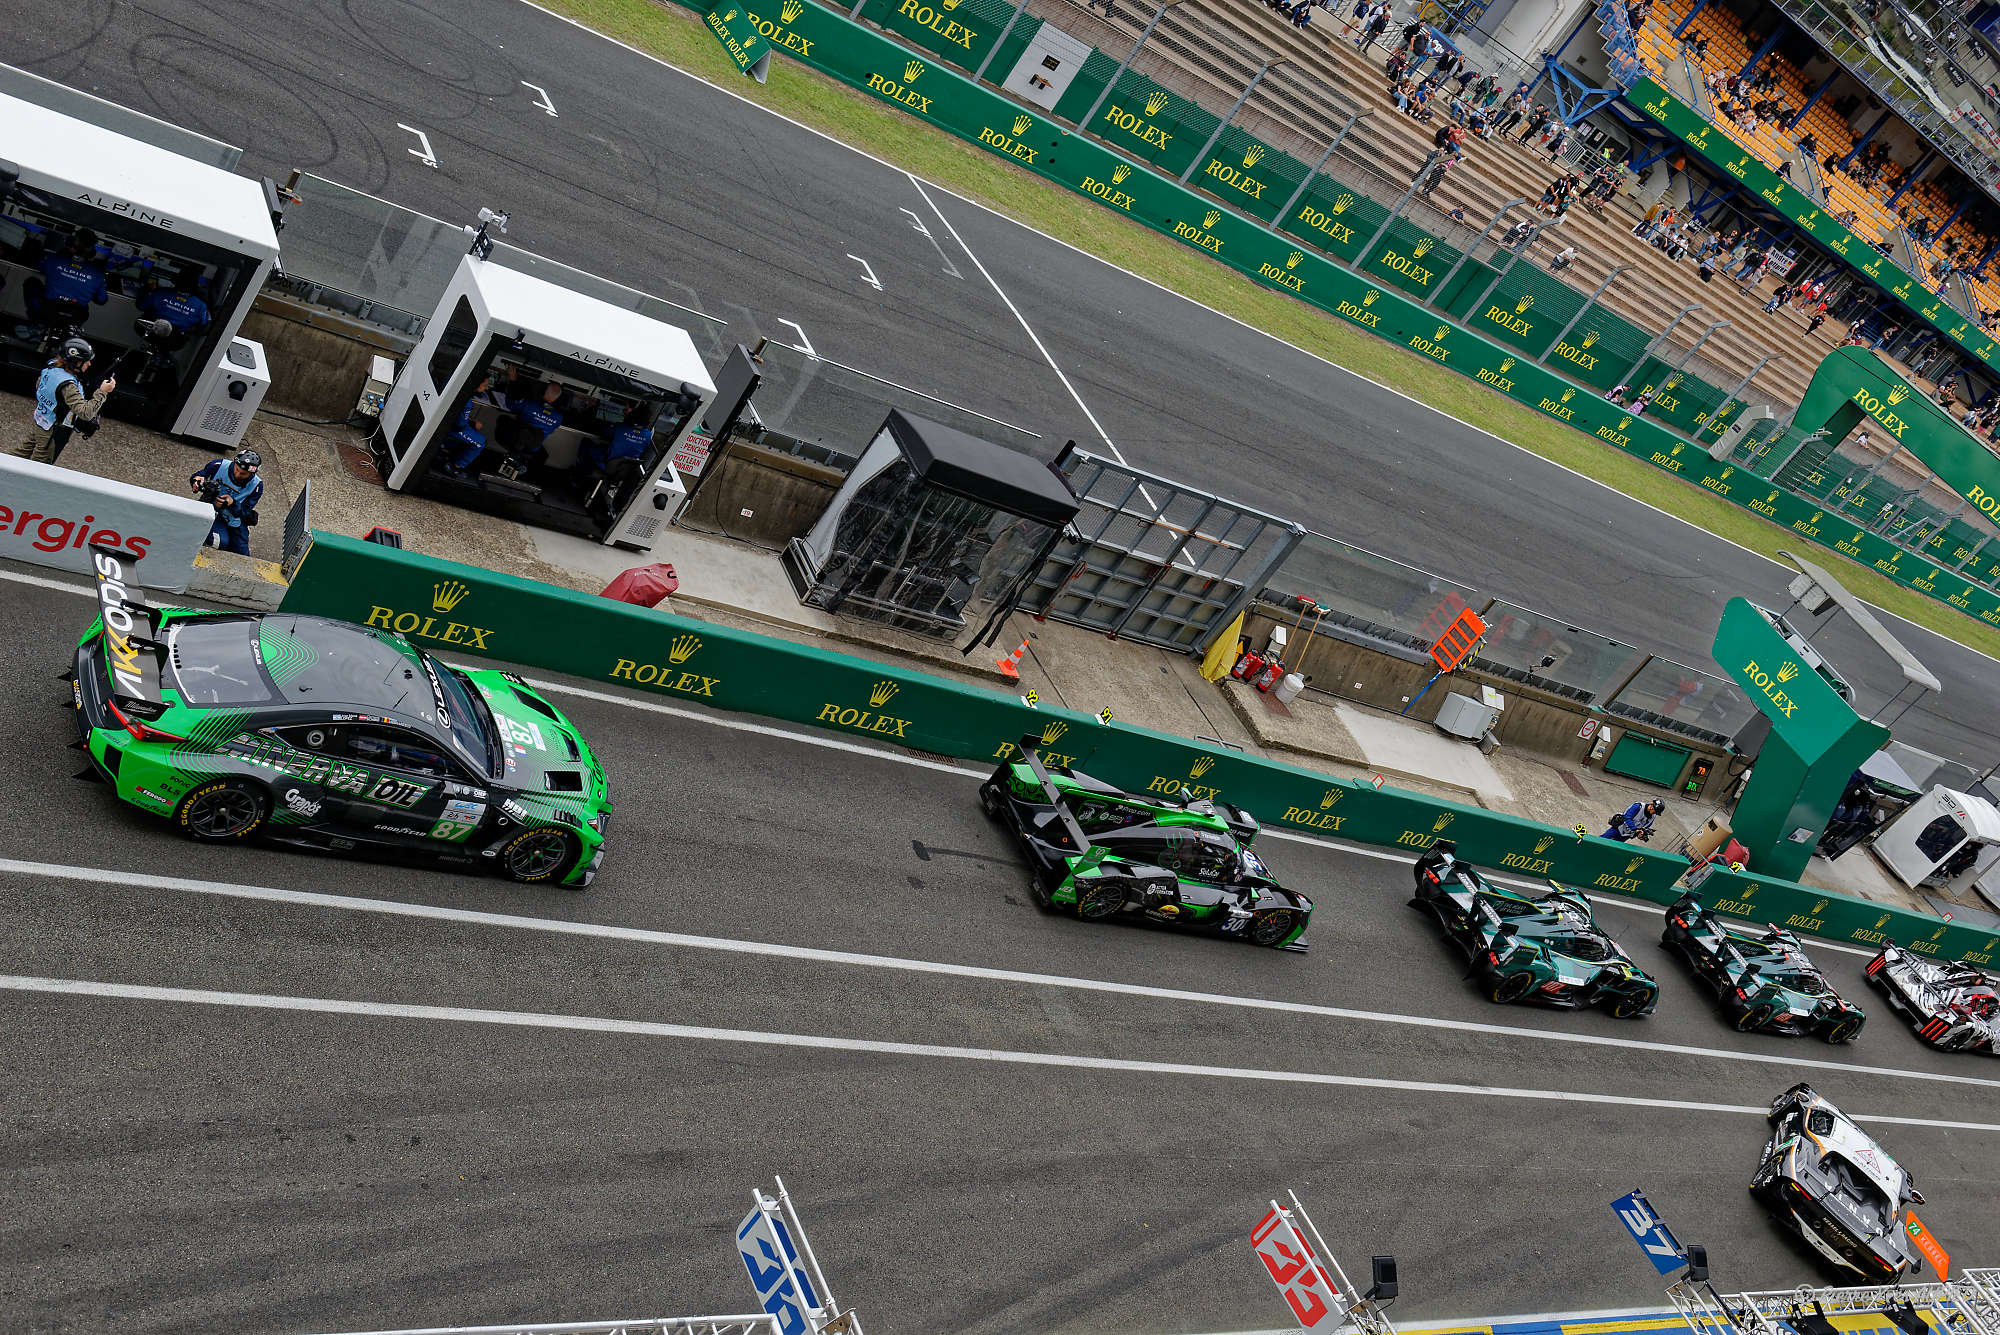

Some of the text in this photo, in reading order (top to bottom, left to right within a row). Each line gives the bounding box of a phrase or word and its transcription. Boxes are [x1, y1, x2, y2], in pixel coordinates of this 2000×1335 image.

[708, 12, 729, 40] ROLEX
[748, 12, 815, 57] ROLEX
[898, 0, 978, 49] ROLEX
[727, 37, 750, 68] ROLEX
[866, 73, 933, 114] ROLEX
[1645, 102, 1667, 121] ROLEX
[1104, 105, 1173, 150] ROLEX
[978, 127, 1039, 164] ROLEX
[1686, 132, 1708, 150] ROLEX
[1205, 158, 1268, 199] ROLEX
[1726, 161, 1747, 179] ROLEX
[1080, 176, 1136, 211] ROLEX
[1762, 189, 1782, 205] ROLEX
[78, 193, 175, 229] ALPINE
[1298, 205, 1355, 244] ROLEX
[1797, 215, 1816, 230] ROLEX
[1173, 222, 1225, 253] ROLEX
[1830, 241, 1848, 255] ROLEX
[56, 265, 93, 281] ALPINE
[1258, 263, 1306, 292] ROLEX
[1381, 250, 1434, 286] ROLEX
[1862, 263, 1880, 278] ROLEX
[1893, 285, 1909, 300] ROLEX
[162, 297, 196, 314] ALPINE
[1336, 300, 1381, 328] ROLEX
[1921, 307, 1938, 320] ROLEX
[1485, 305, 1534, 337] ROLEX
[1949, 328, 1965, 341] ROLEX
[1409, 336, 1450, 361] ROLEX
[1554, 341, 1599, 371] ROLEX
[570, 351, 640, 378] ALPINE
[1476, 368, 1516, 392] ROLEX
[532, 411, 558, 425] ALPINE
[1538, 398, 1575, 421] ROLEX
[1852, 387, 1910, 438] ROLEX
[1596, 425, 1631, 447] ROLEX
[1650, 452, 1683, 472] ROLEX
[1701, 476, 1730, 496] ROLEX
[1835, 486, 1865, 507] ROEX
[1748, 499, 1776, 517] ROLEX
[1966, 485, 2000, 525] ROL
[1793, 520, 1820, 538] ROLEX
[1835, 539, 1861, 556] ROLEX
[1874, 559, 1899, 575] ROLEX
[1912, 577, 1936, 592] ROLEX
[1947, 594, 1971, 608] ROLEX
[363, 605, 496, 650] ROLEX
[423, 659, 445, 708] LEXUS
[609, 659, 721, 697] ROLEX
[1744, 660, 1798, 719] ROLEX
[816, 703, 912, 740] ROLEX
[512, 721, 534, 745] 87
[993, 742, 1077, 769] RLEX
[209, 731, 422, 808] MINERVA OIL
[1146, 776, 1222, 803] ROLEX
[1281, 807, 1348, 830] ROLEX
[374, 823, 427, 837] GOODYEAR
[432, 820, 469, 841] 87
[1575, 823, 1587, 837] 92
[1501, 853, 1553, 874] ROLEX
[1730, 862, 1741, 873] 91
[1593, 874, 1642, 892] ROLEX
[1713, 899, 1757, 915] ROLEX
[1222, 918, 1246, 932] 30
[1785, 914, 1824, 930] ROLEX
[1850, 929, 1886, 943] ROLEX
[1909, 941, 1941, 954] ROLEX
[1963, 952, 1993, 964] ROLEX
[1620, 1199, 1683, 1258] 37
[1908, 1222, 1921, 1235] 74
